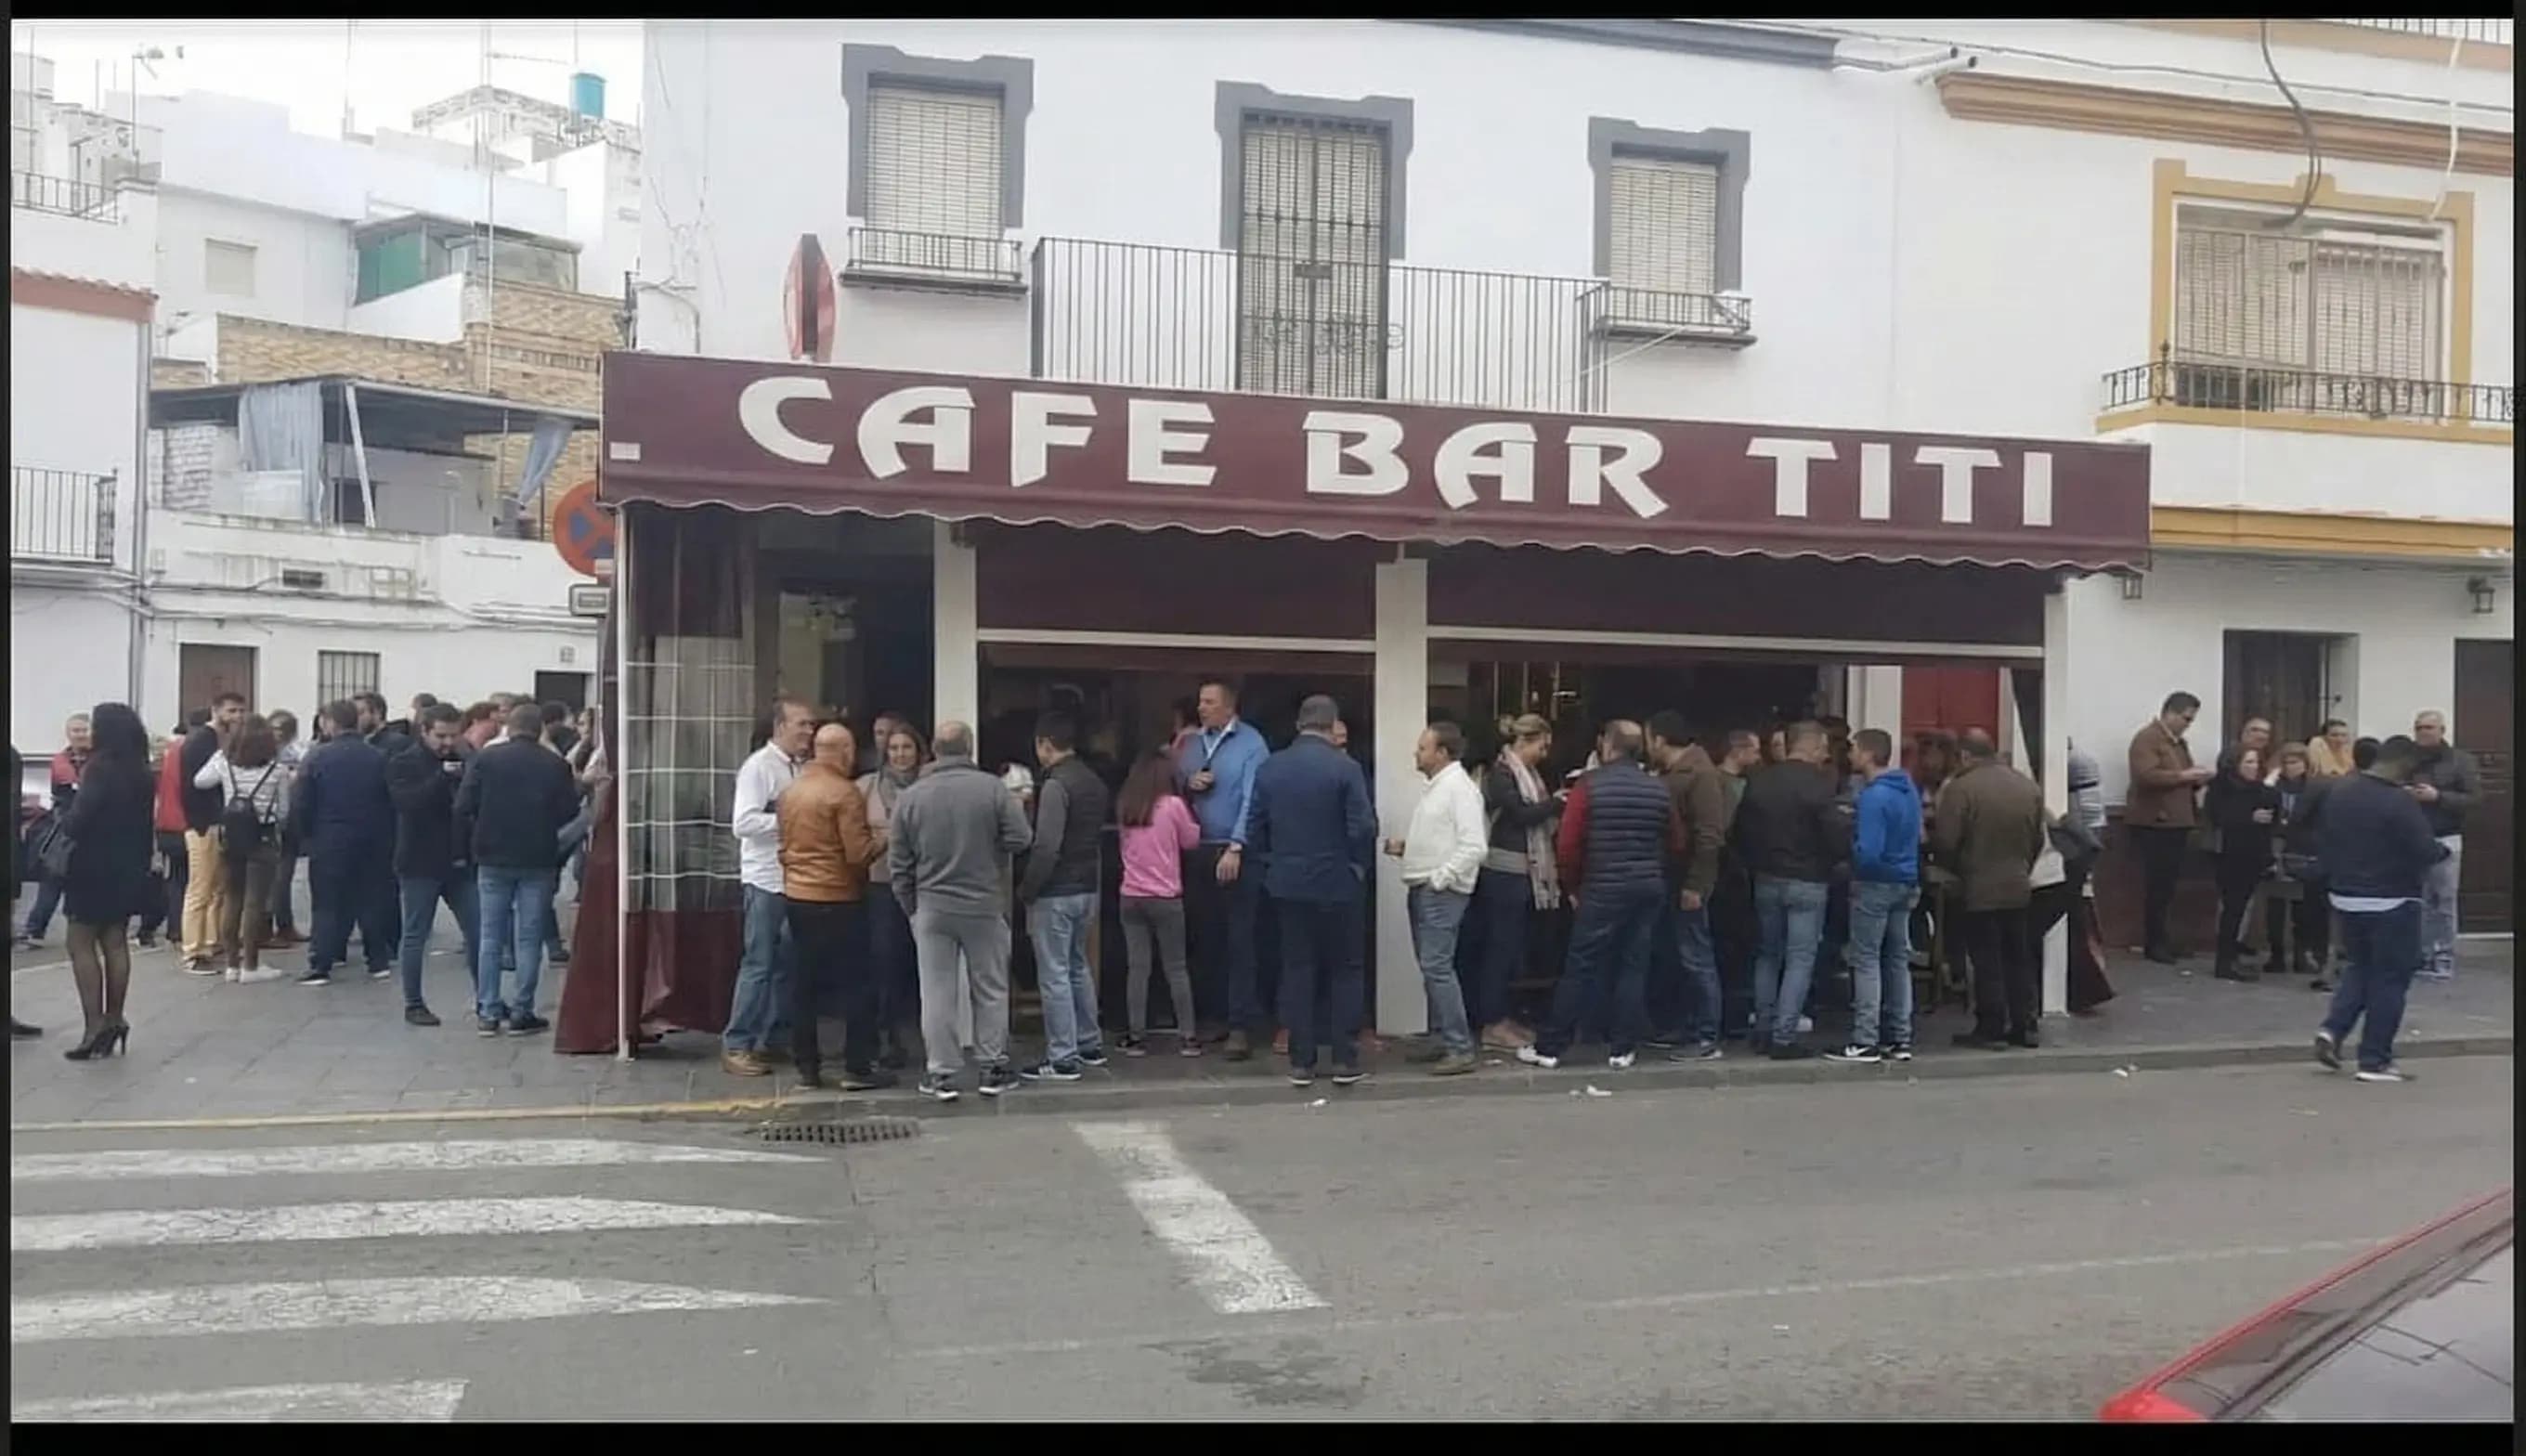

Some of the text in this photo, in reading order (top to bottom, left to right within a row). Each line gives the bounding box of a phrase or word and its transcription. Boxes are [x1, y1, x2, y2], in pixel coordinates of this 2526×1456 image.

[739, 376, 2053, 526] CAFE BAR TITI
